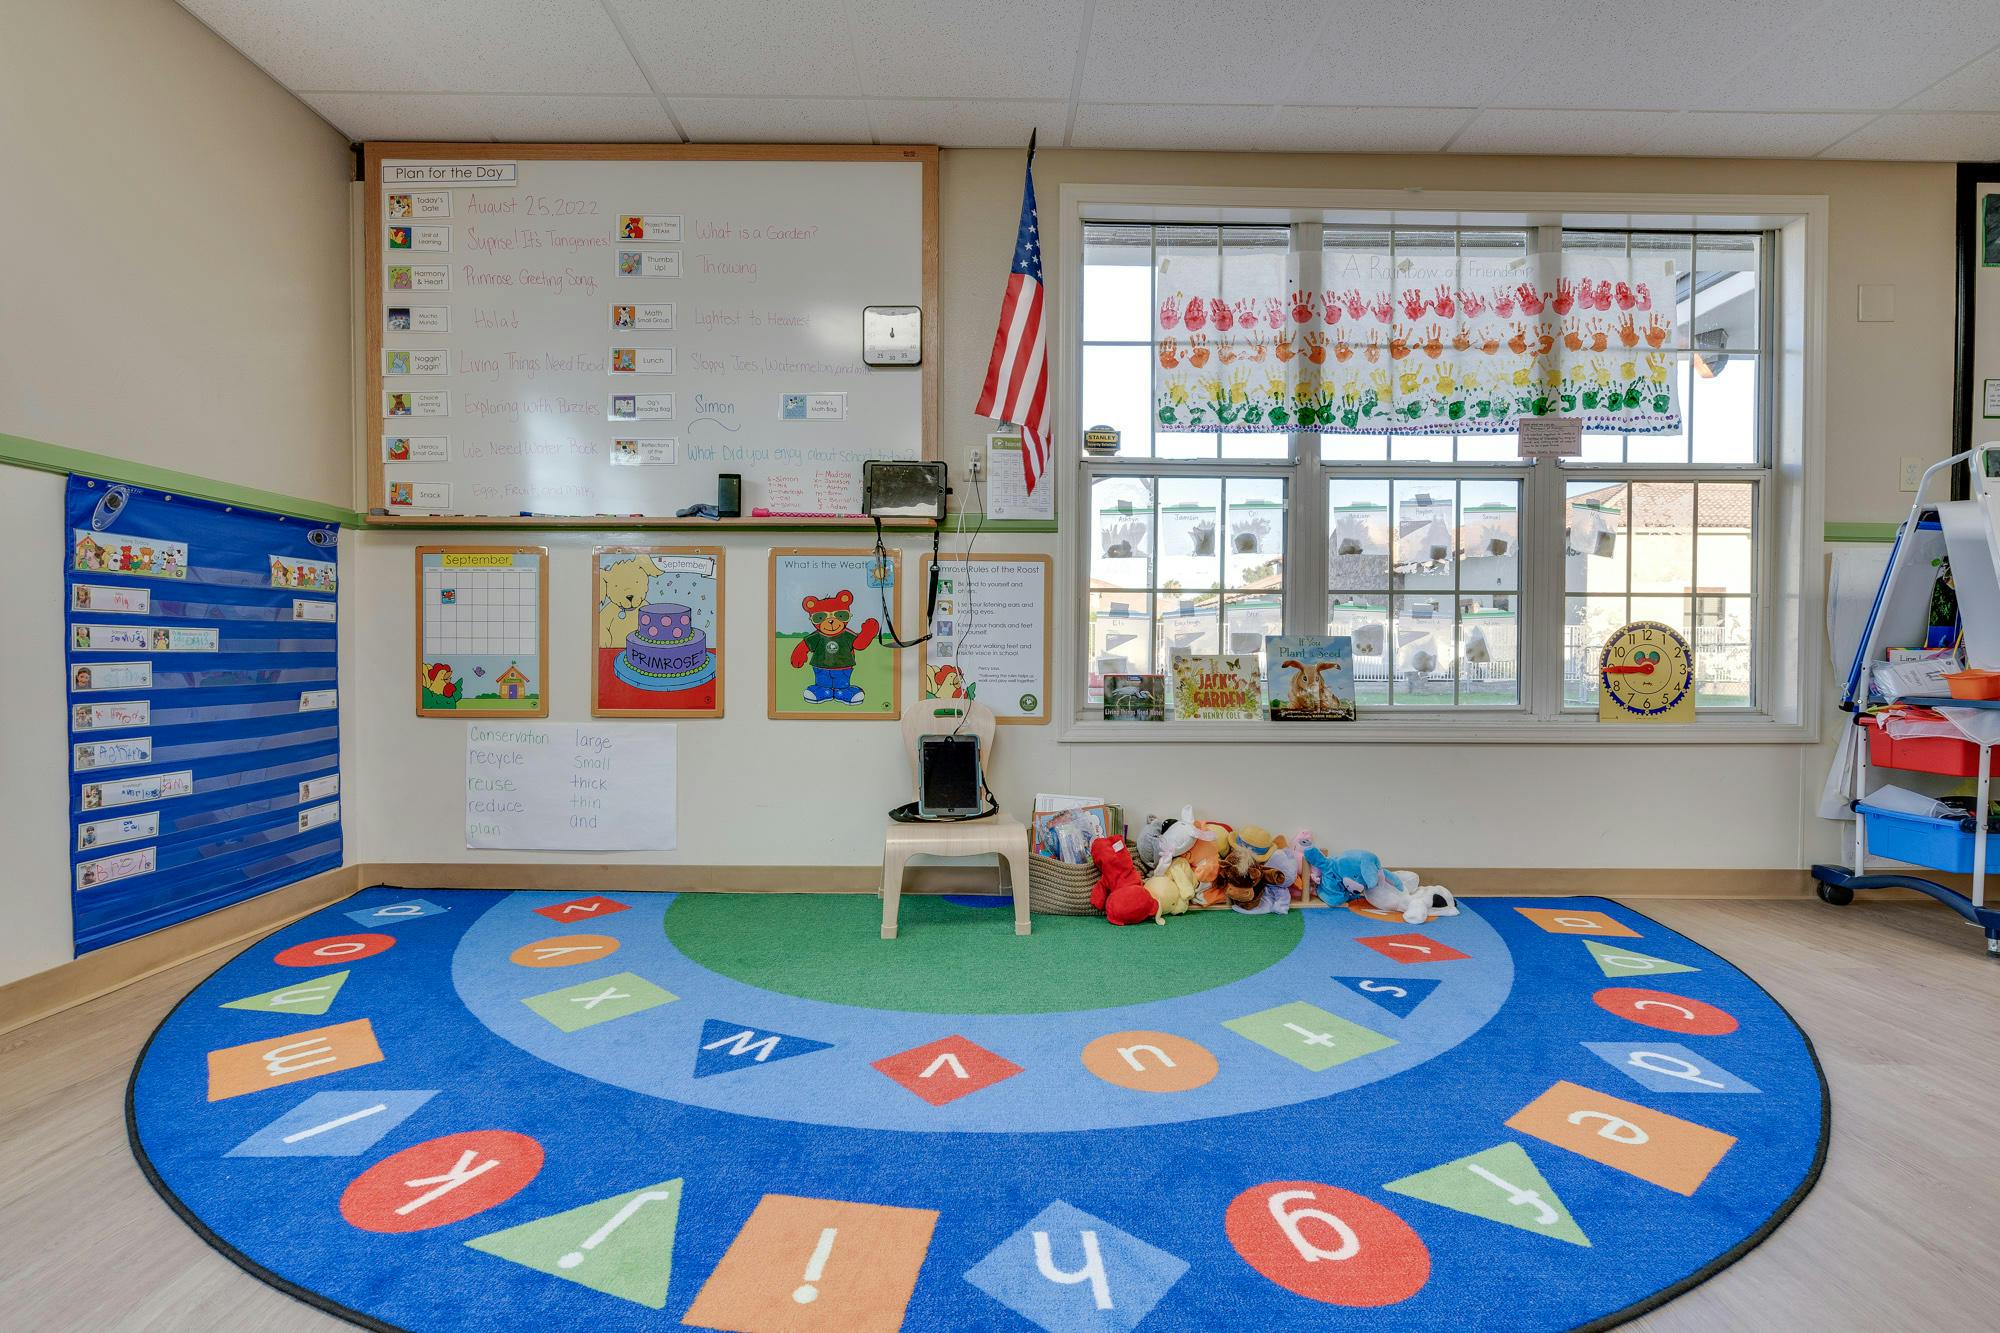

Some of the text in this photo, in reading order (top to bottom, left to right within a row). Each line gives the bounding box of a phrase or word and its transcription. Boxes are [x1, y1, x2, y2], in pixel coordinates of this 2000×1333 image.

[396, 167, 504, 181] Plan for the Day
[417, 197, 444, 206] Today's
[421, 205, 440, 213] Date
[466, 193, 517, 216] August
[695, 219, 732, 240] What
[738, 226, 750, 239] is
[753, 230, 762, 239] a
[415, 271, 446, 279] Harmony
[654, 263, 667, 273] Up!
[696, 255, 758, 283] Throwing
[1342, 254, 1361, 279] A
[1369, 255, 1439, 281] Rainbow
[424, 278, 444, 286] Heart
[463, 265, 563, 295] Primrose Greeting
[459, 350, 499, 382] Living
[504, 352, 541, 380] Things
[545, 351, 573, 371] Need
[464, 392, 519, 423] Exploring
[695, 393, 735, 415] Simon
[688, 444, 715, 461] What
[722, 444, 744, 461] Did
[745, 449, 769, 467] you
[446, 554, 509, 567] September
[663, 560, 705, 570] September
[785, 560, 836, 569] What is the
[991, 565, 999, 573] of
[1017, 566, 1039, 574] Roost
[1299, 638, 1321, 647] If You
[1628, 634, 1636, 645] 11
[1642, 630, 1653, 640] 12
[1662, 634, 1666, 645] 1
[632, 649, 699, 670] PRIMROSE
[1280, 647, 1341, 658] Plant Seed
[1614, 647, 1625, 658] 10
[1674, 647, 1681, 658] 2
[1680, 664, 1687, 675] 3
[1199, 673, 1239, 690] JACK'S
[1613, 680, 1620, 691] 8
[1674, 682, 1681, 692] 4
[1194, 690, 1246, 708] GARDEN
[1627, 693, 1635, 704] 7
[1643, 698, 1651, 709] 6
[1661, 693, 1669, 704] 5
[1105, 708, 1149, 716] Living Things Need
[1203, 711, 1241, 720] HENRY COLE
[470, 725, 549, 745] Conservation
[575, 728, 613, 753] large
[469, 749, 525, 769] recycle
[468, 776, 518, 792] reuse
[569, 774, 608, 791] thick
[468, 799, 525, 813] reduce
[569, 793, 601, 809] thin
[569, 814, 598, 829] and
[469, 822, 501, 840] plan
[1554, 916, 1602, 929] a
[314, 942, 366, 957] o
[533, 945, 602, 961] y
[1388, 942, 1432, 955] r
[1359, 979, 1406, 998] s
[571, 987, 631, 1010] x
[1634, 1001, 1695, 1020] c
[1284, 1022, 1336, 1048] t
[704, 1031, 781, 1062] w
[263, 1037, 336, 1077] m
[918, 1053, 970, 1079] v
[1567, 1110, 1649, 1145] e
[395, 1150, 500, 1215] k
[1466, 1163, 1559, 1225] f
[557, 1190, 669, 1270] j
[1267, 1189, 1361, 1262] g
[1033, 1231, 1113, 1310] h
